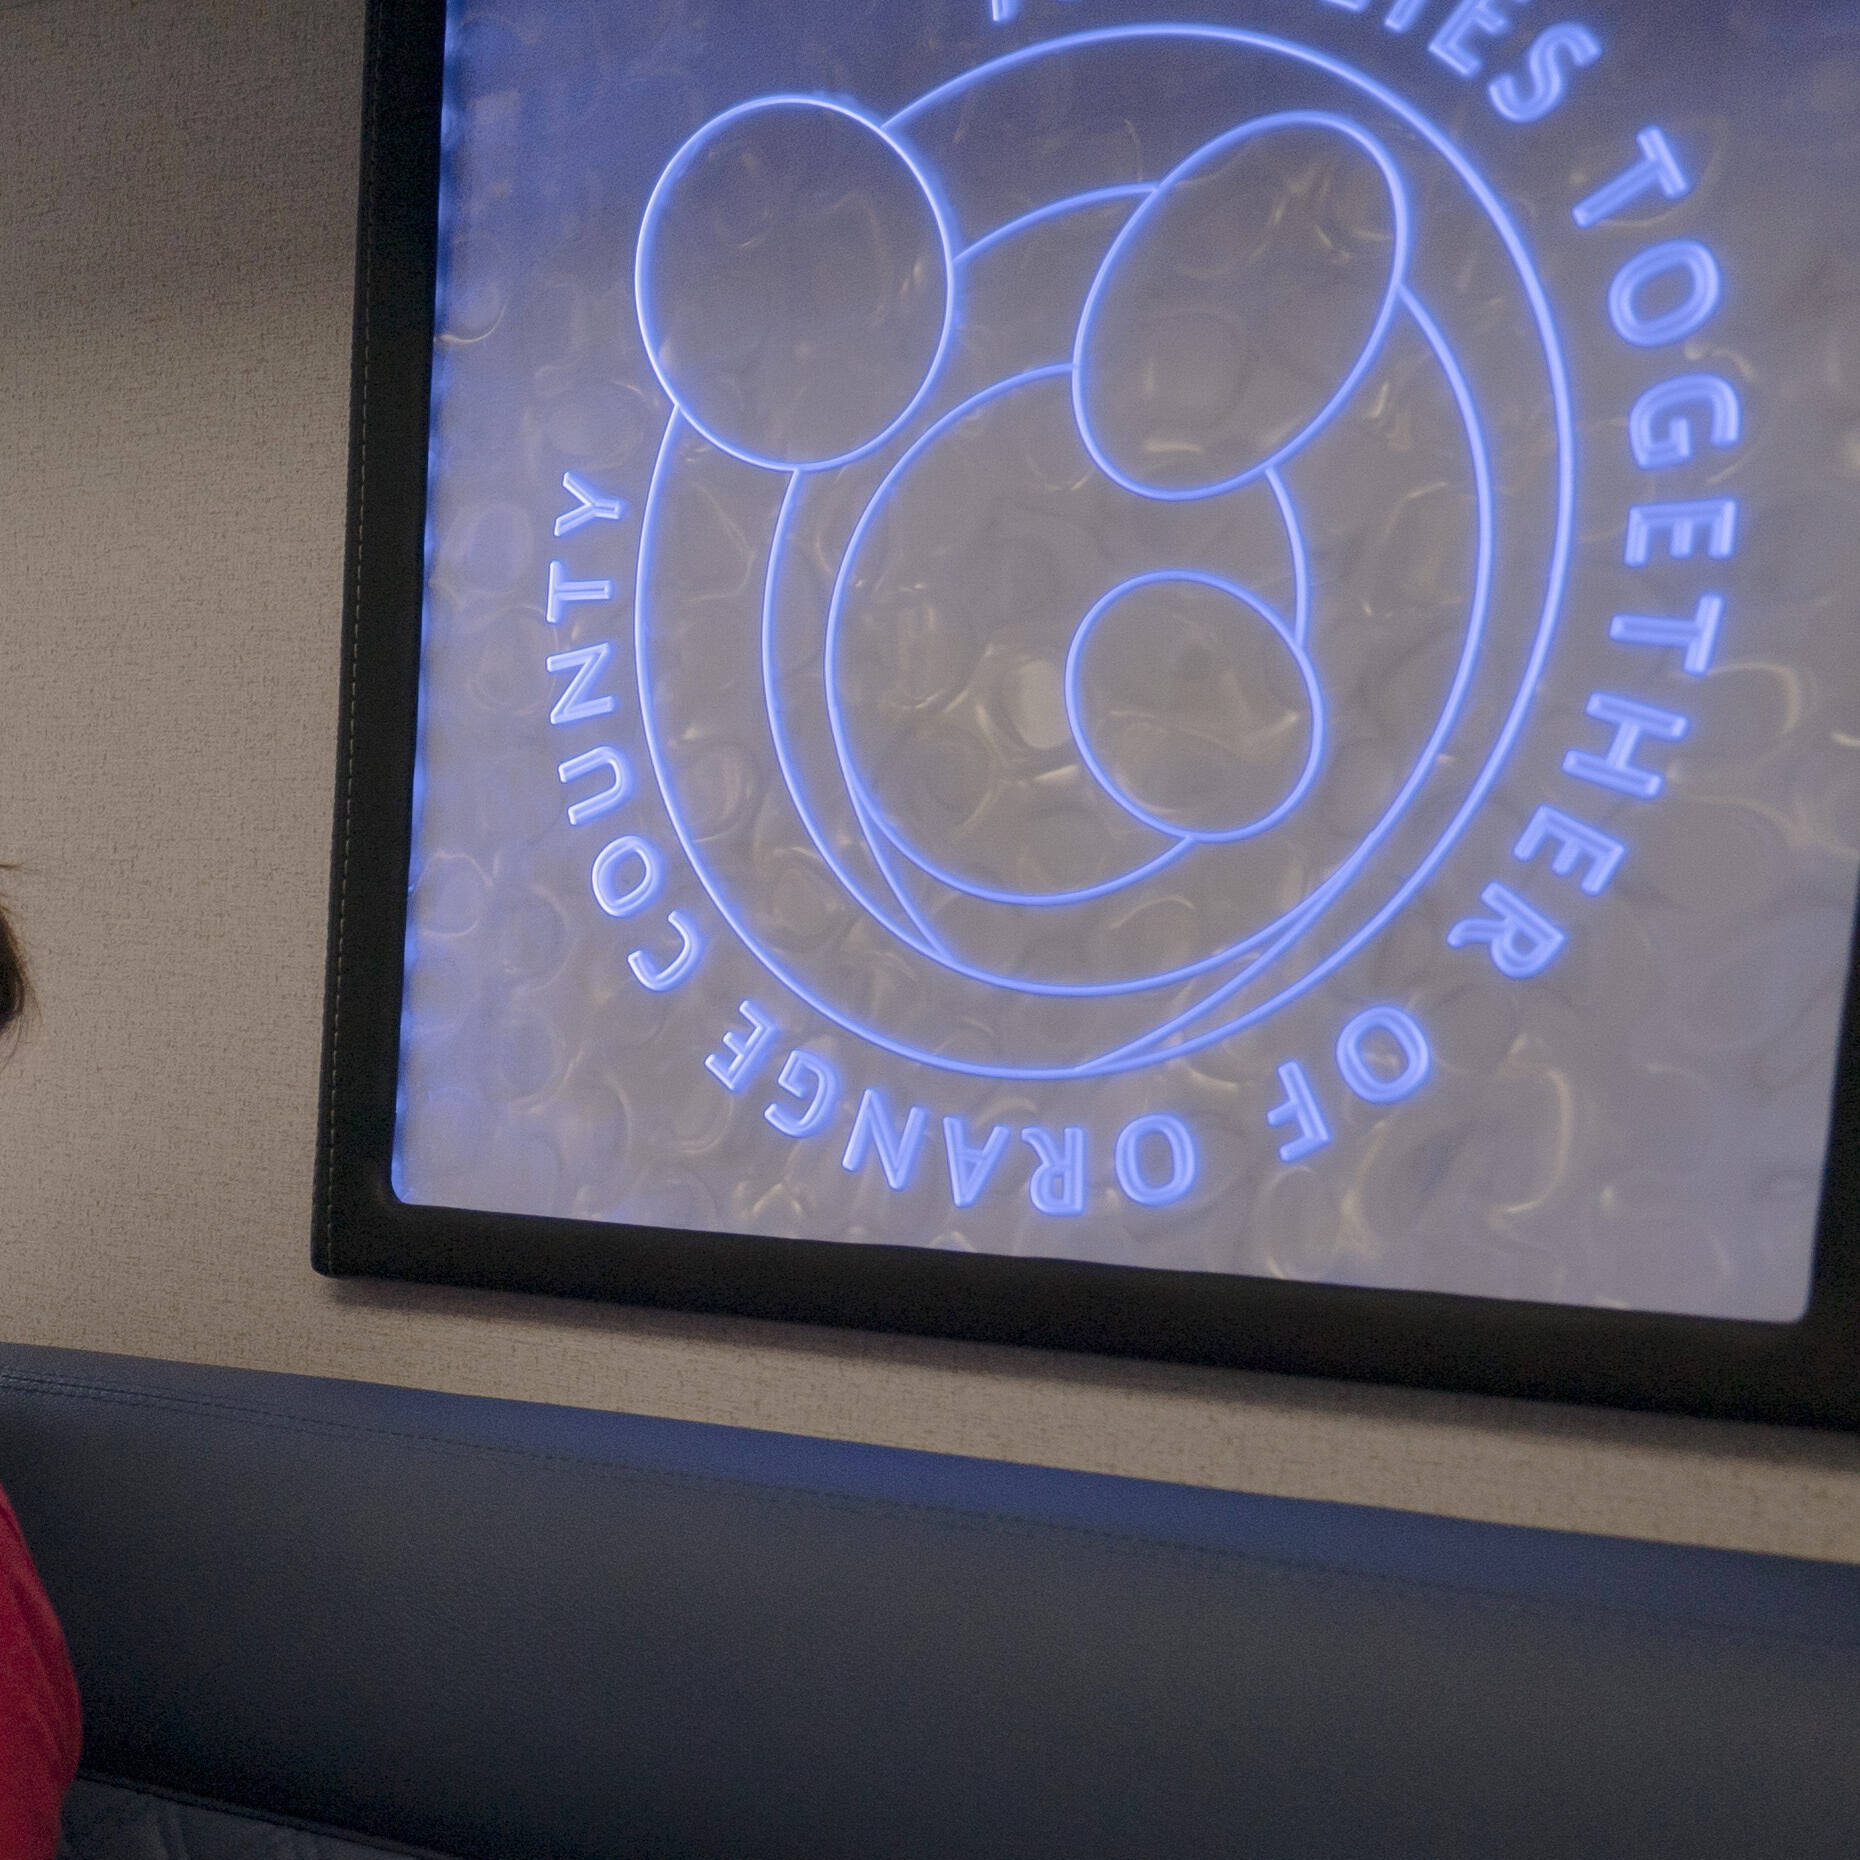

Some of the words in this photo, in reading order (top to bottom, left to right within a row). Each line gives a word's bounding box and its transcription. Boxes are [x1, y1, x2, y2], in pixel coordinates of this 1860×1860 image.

[545, 470, 704, 991] COUNTY
[1445, 124, 1741, 981] TOGETHER
[704, 998, 1196, 1216] ORANGE
[1266, 1004, 1433, 1162] OF
